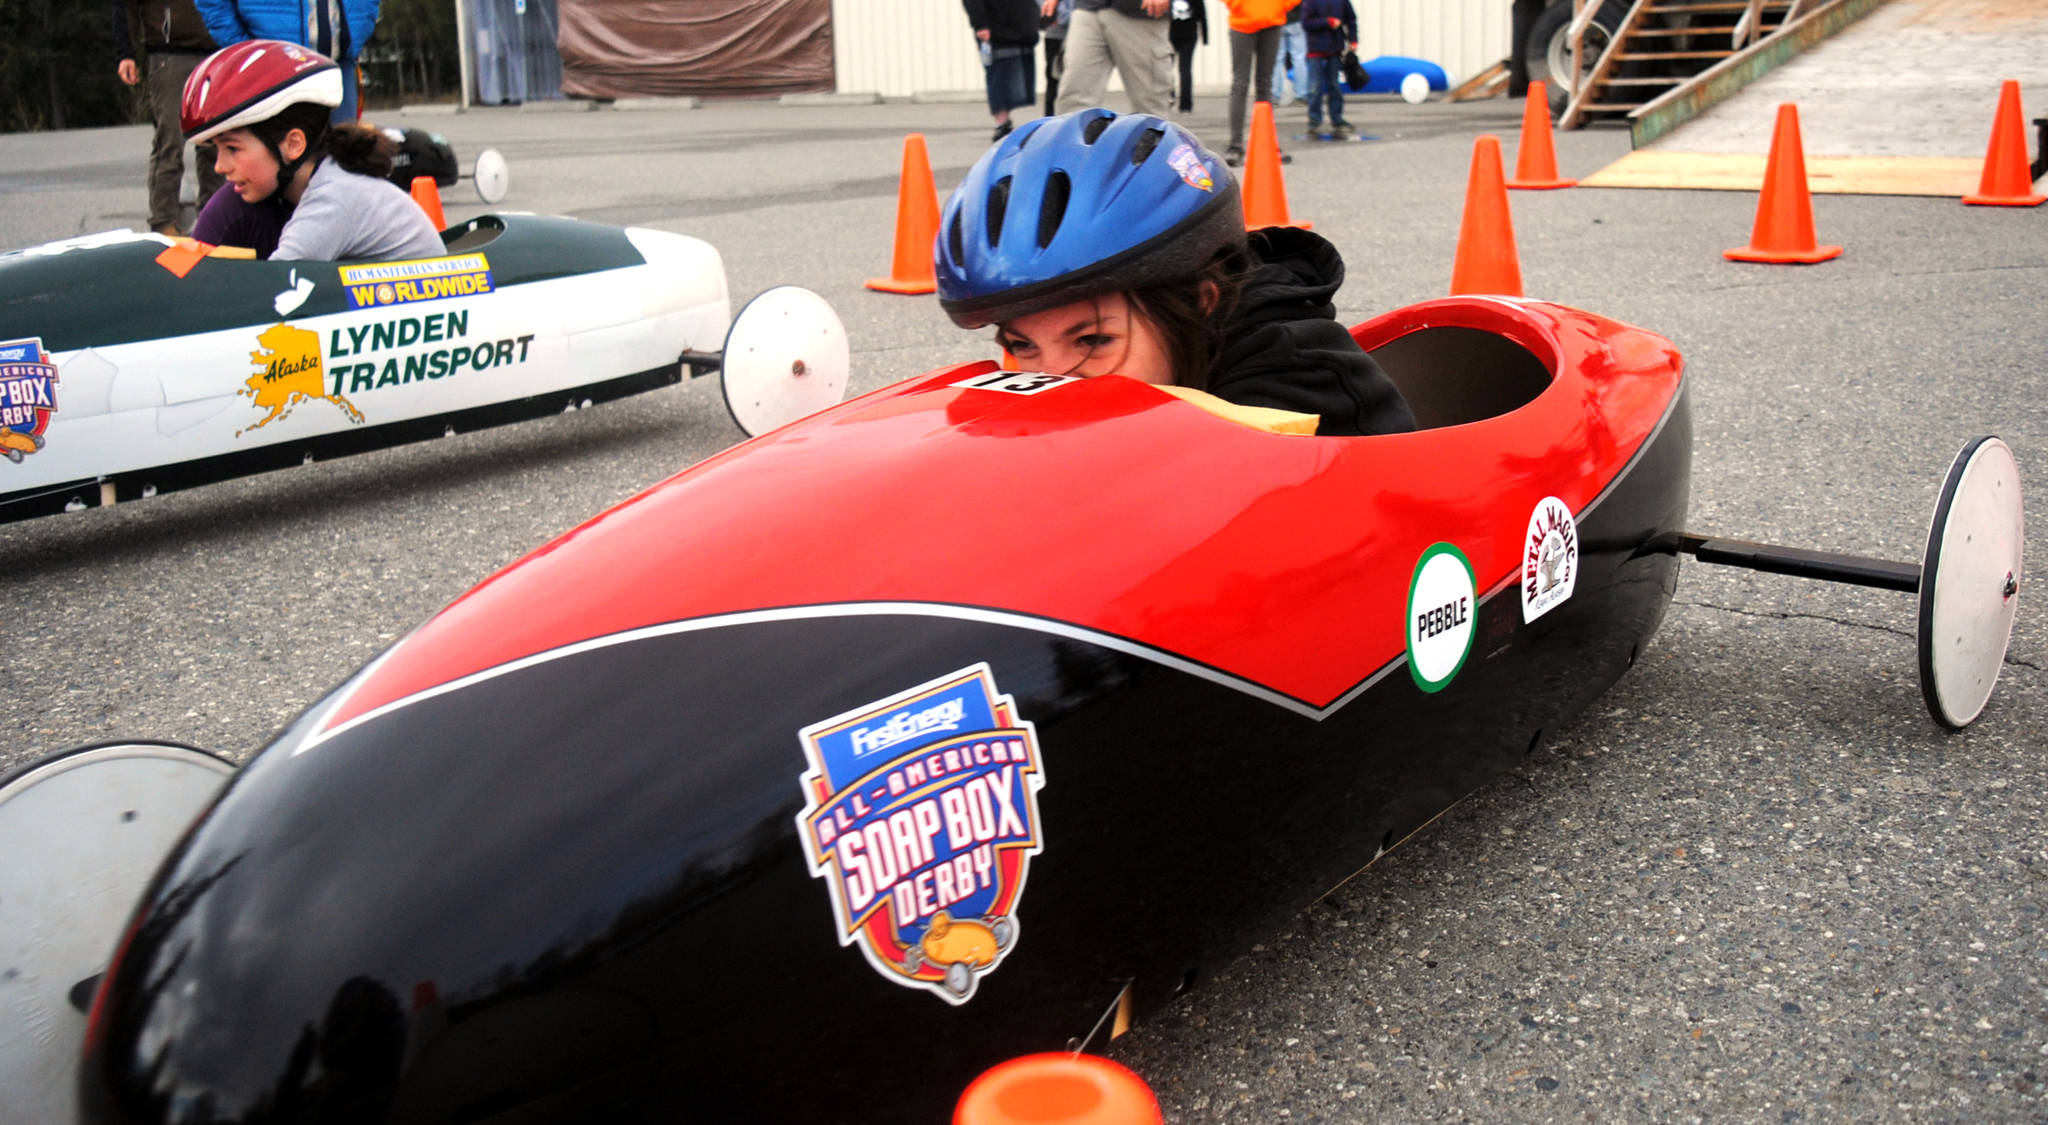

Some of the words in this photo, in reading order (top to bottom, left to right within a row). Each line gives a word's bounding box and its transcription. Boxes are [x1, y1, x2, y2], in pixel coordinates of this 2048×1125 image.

[348, 263, 434, 281] HUMANITARIAN
[438, 257, 482, 272] SERVICE
[351, 273, 491, 307] WORLDWIDE
[329, 309, 468, 359] LYNDEN
[0, 366, 54, 377] ERICAN
[263, 354, 319, 384] Alaska
[329, 334, 535, 396] TRANSPORT
[970, 372, 1065, 391] 13
[8, 377, 52, 406] BOX
[1526, 518, 1547, 606] METAL
[1546, 505, 1576, 563] MAGIC
[1418, 596, 1467, 642] PEBBLE
[851, 697, 965, 757] FirstEnergy
[816, 740, 1028, 846] ALL-AMERICAN
[836, 799, 942, 912] SOAP
[941, 764, 1028, 851] BOX
[893, 844, 993, 928] DERBY
